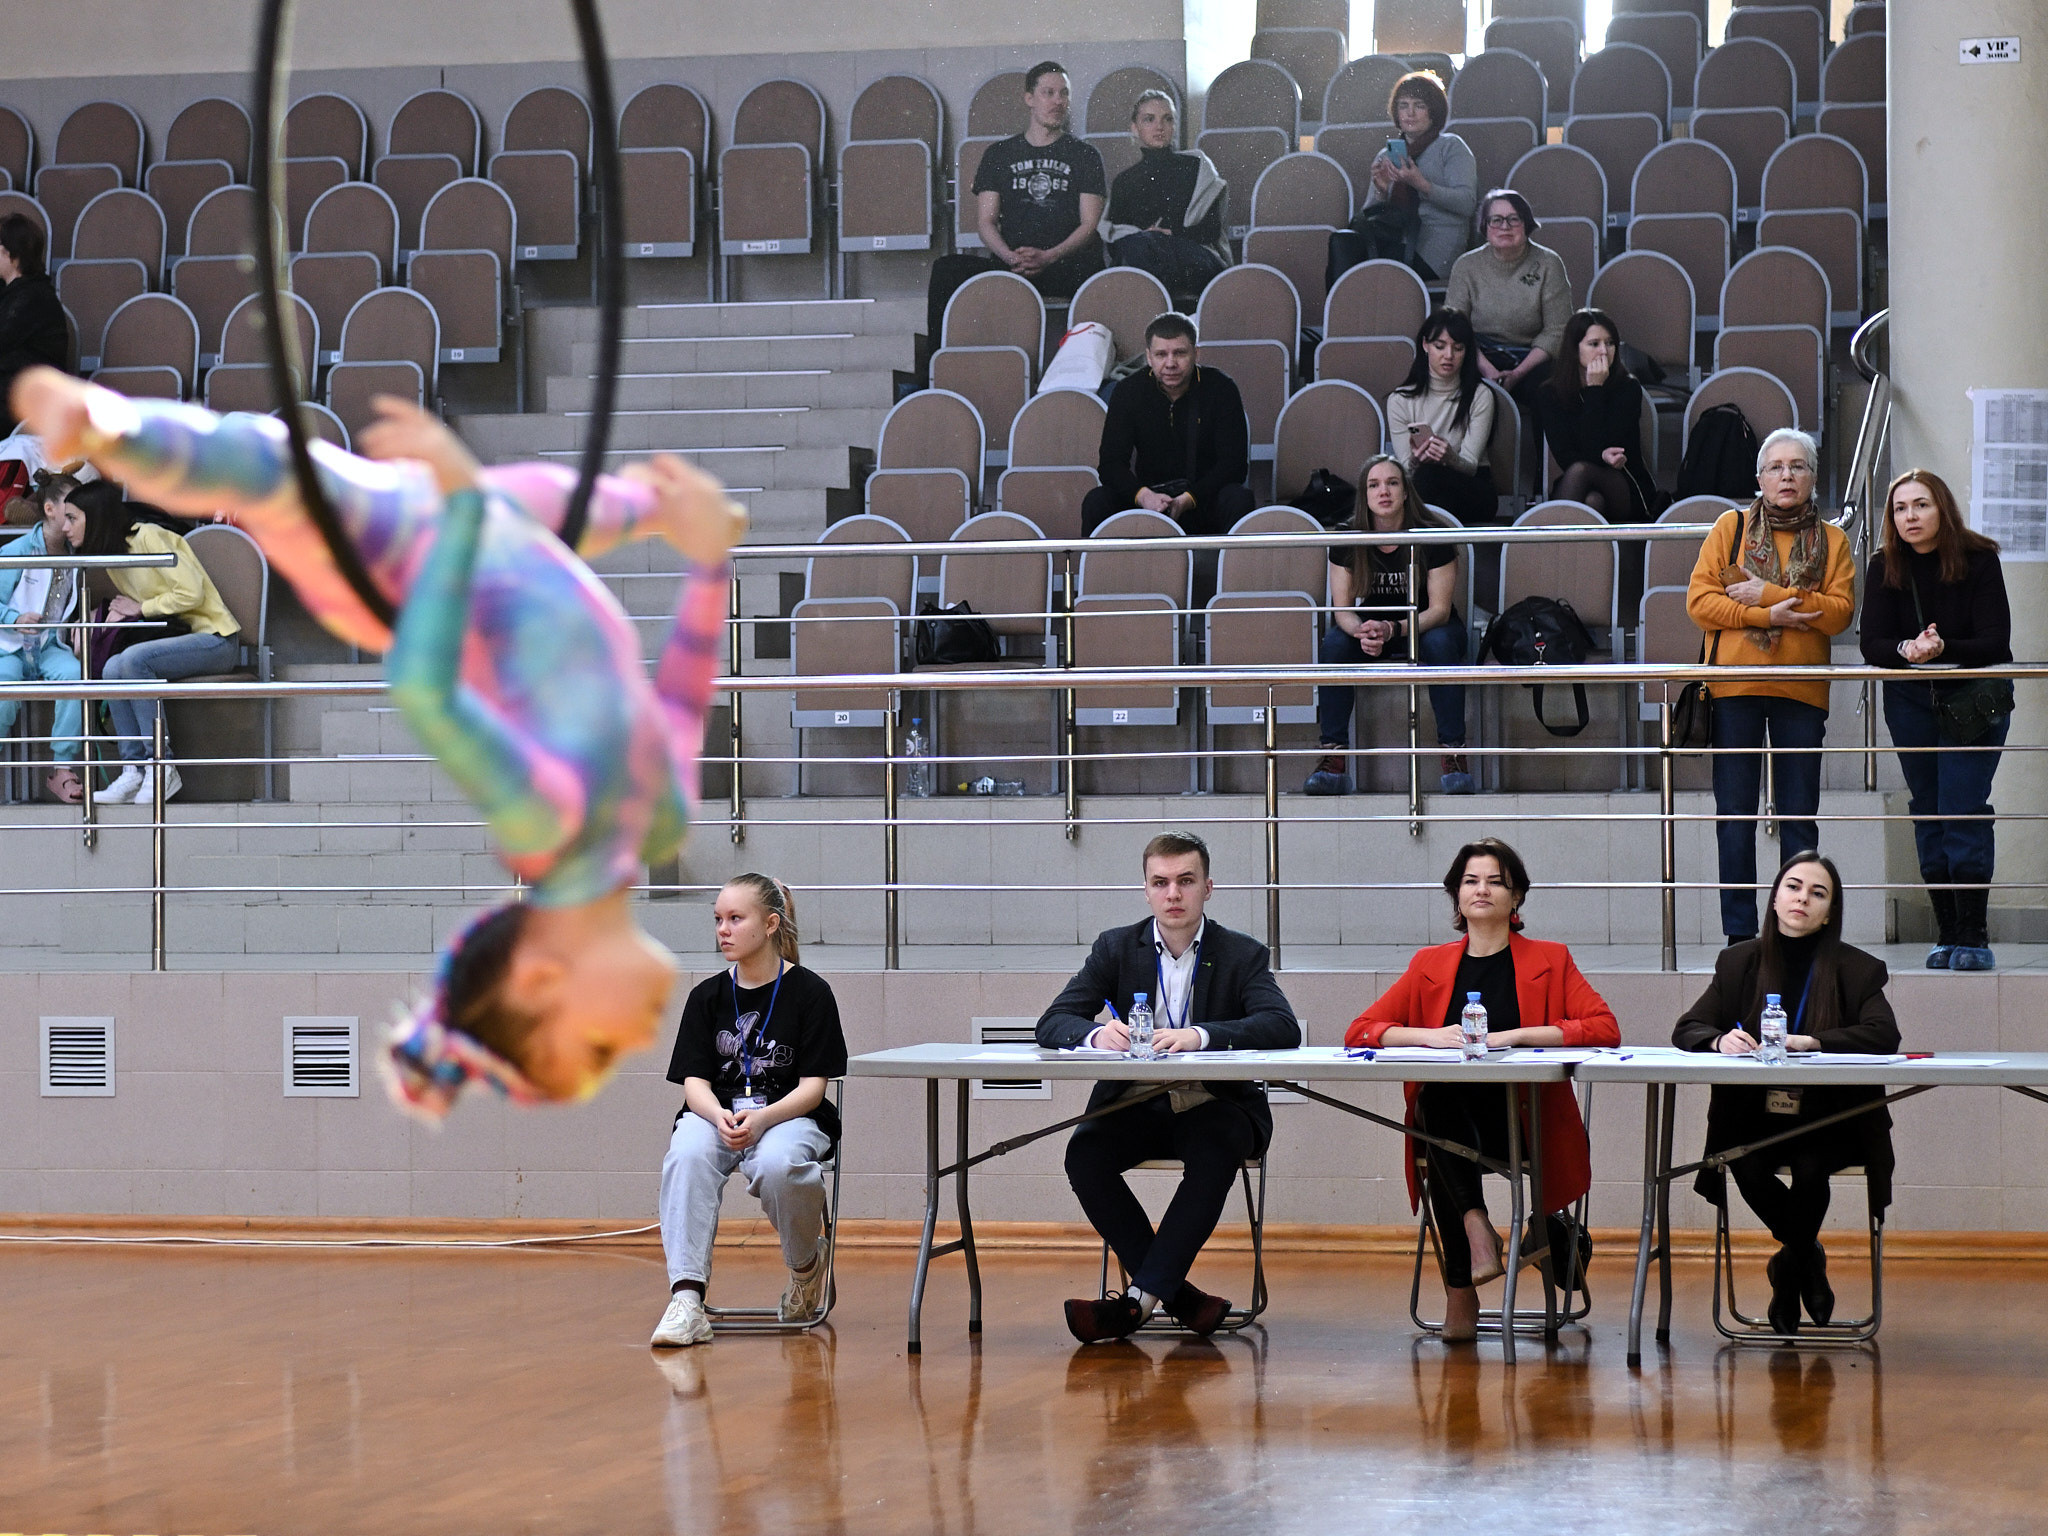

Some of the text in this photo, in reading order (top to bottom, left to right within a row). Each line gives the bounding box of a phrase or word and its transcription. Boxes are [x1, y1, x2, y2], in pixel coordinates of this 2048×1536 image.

[1987, 41, 2009, 51] VIP
[1010, 159, 1034, 173] TOM
[1012, 177, 1027, 190] 19
[1052, 178, 1069, 191] 62
[837, 713, 848, 721] 20
[1115, 712, 1126, 720] 22
